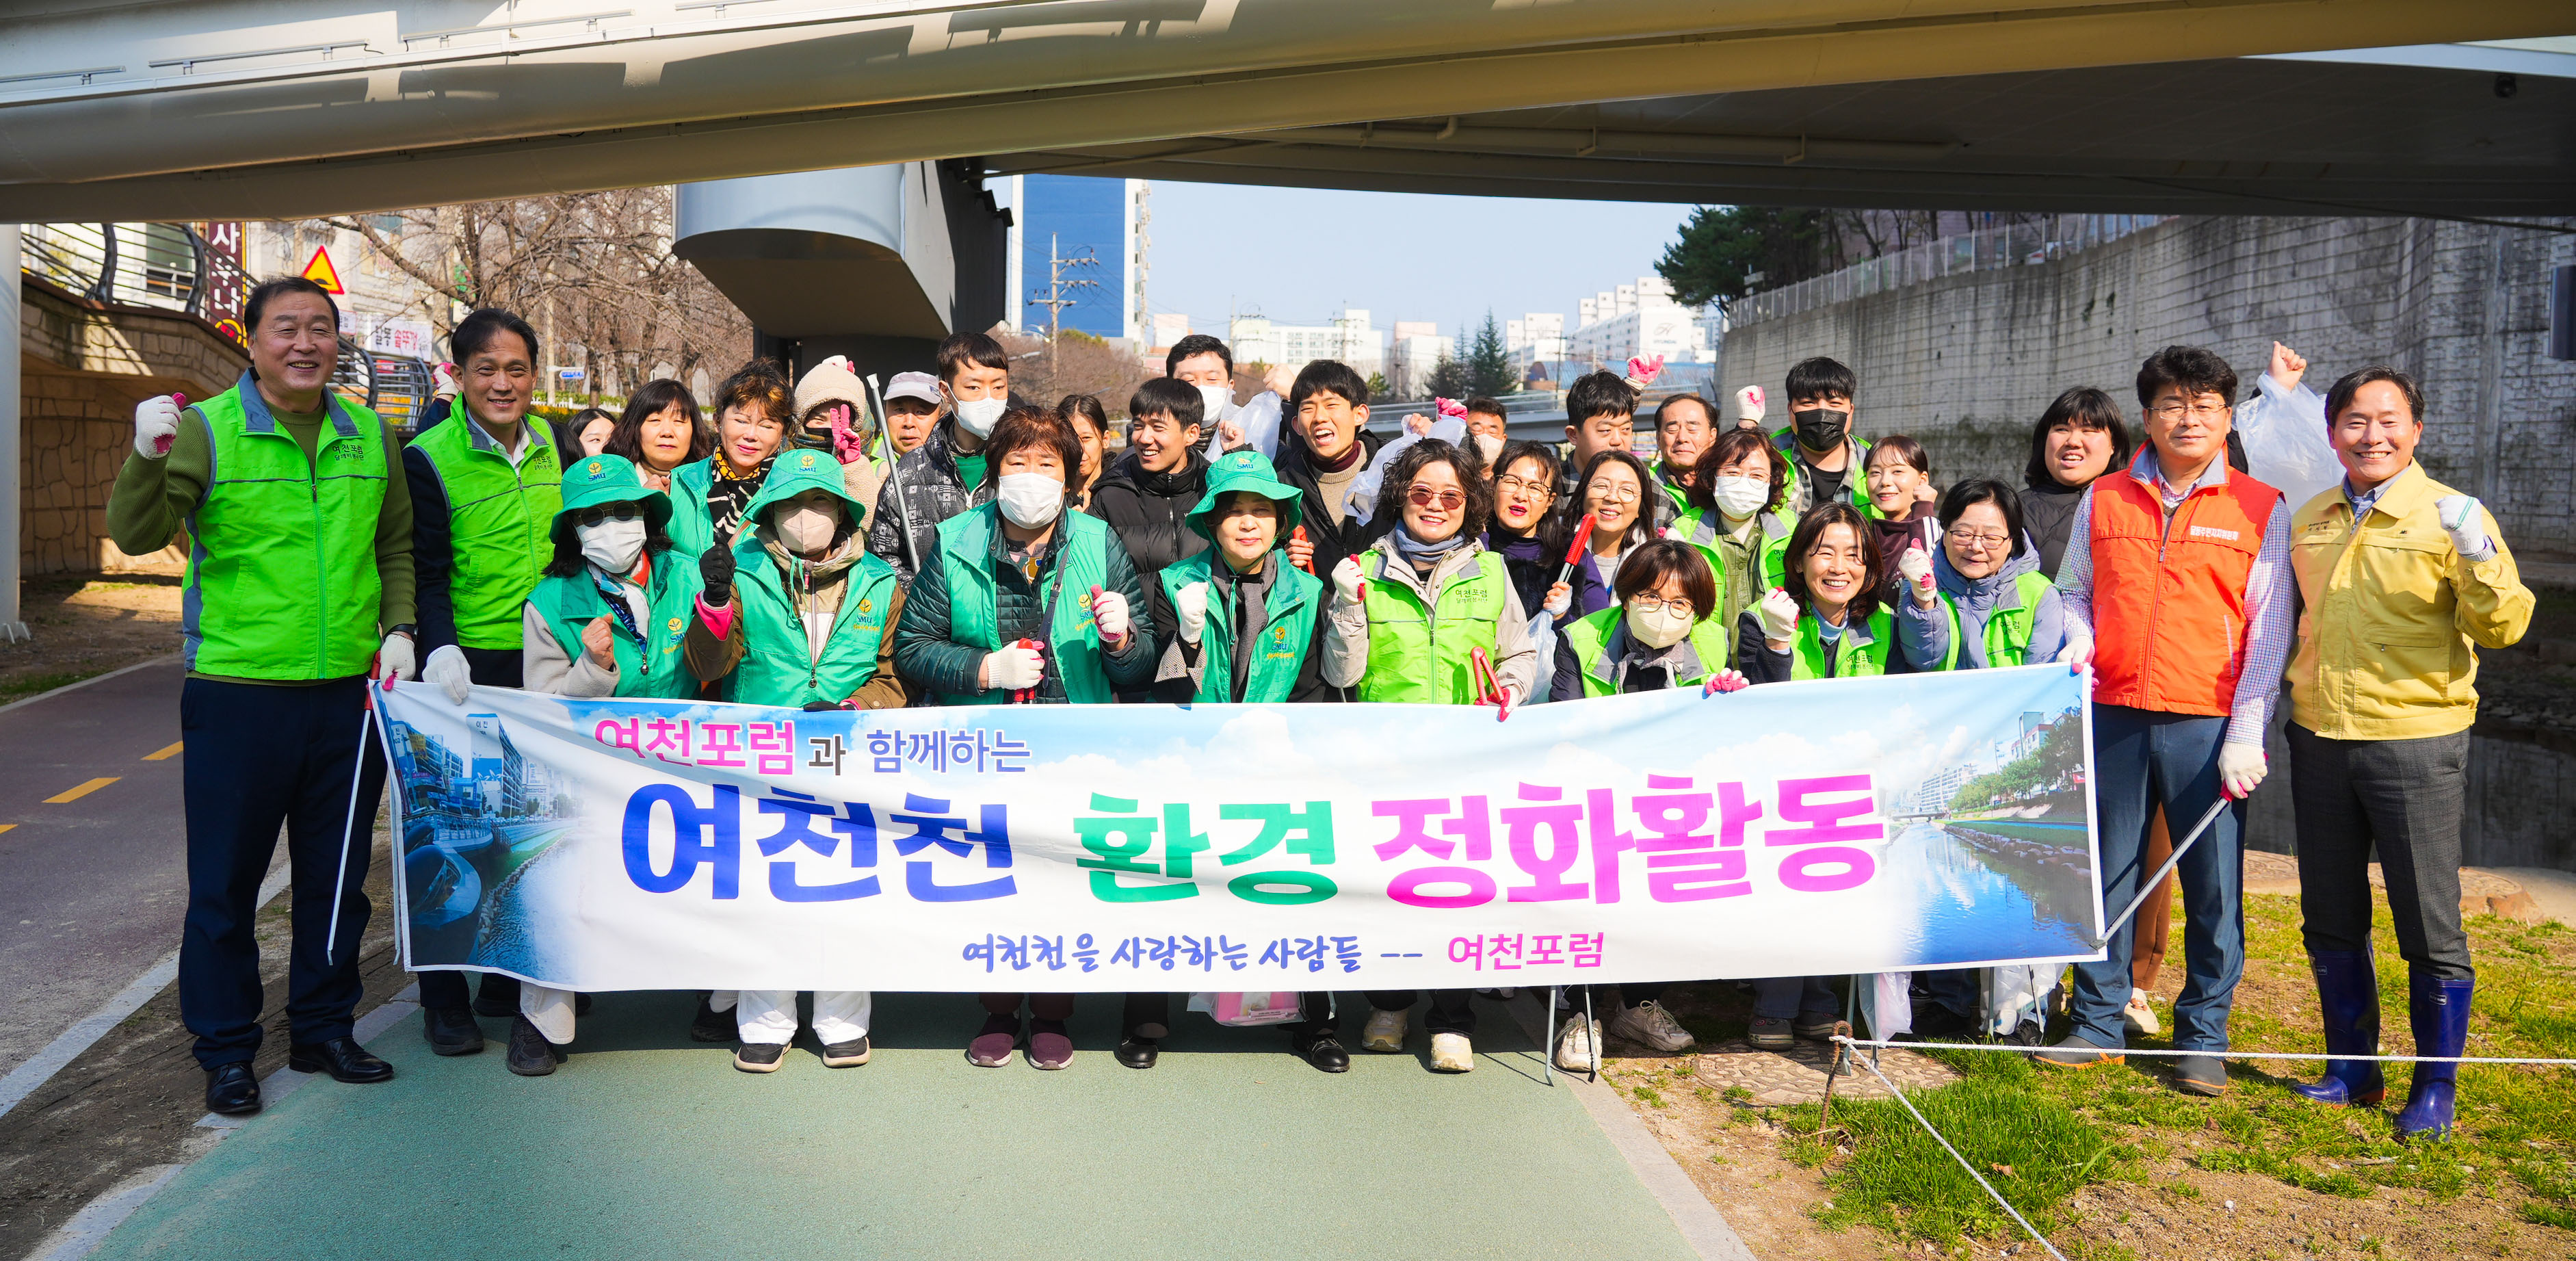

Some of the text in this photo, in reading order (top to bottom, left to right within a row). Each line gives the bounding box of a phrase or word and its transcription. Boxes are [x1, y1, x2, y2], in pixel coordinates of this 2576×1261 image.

[211, 222, 241, 319] 사우나
[332, 443, 364, 455] 여천포럼
[588, 472, 607, 482] SMU
[1455, 588, 1488, 598] 여천포럼
[856, 614, 873, 624] SMU
[670, 632, 686, 643] SM
[595, 718, 1030, 776] 여천포럼 과 함께하는
[621, 773, 1884, 909] 여천천 환경 정화활동
[962, 933, 1100, 974] 여천천을
[1109, 934, 1248, 972] 사랑하는
[1258, 934, 1363, 974] 사람들
[1447, 931, 1604, 972] 여천포럼
